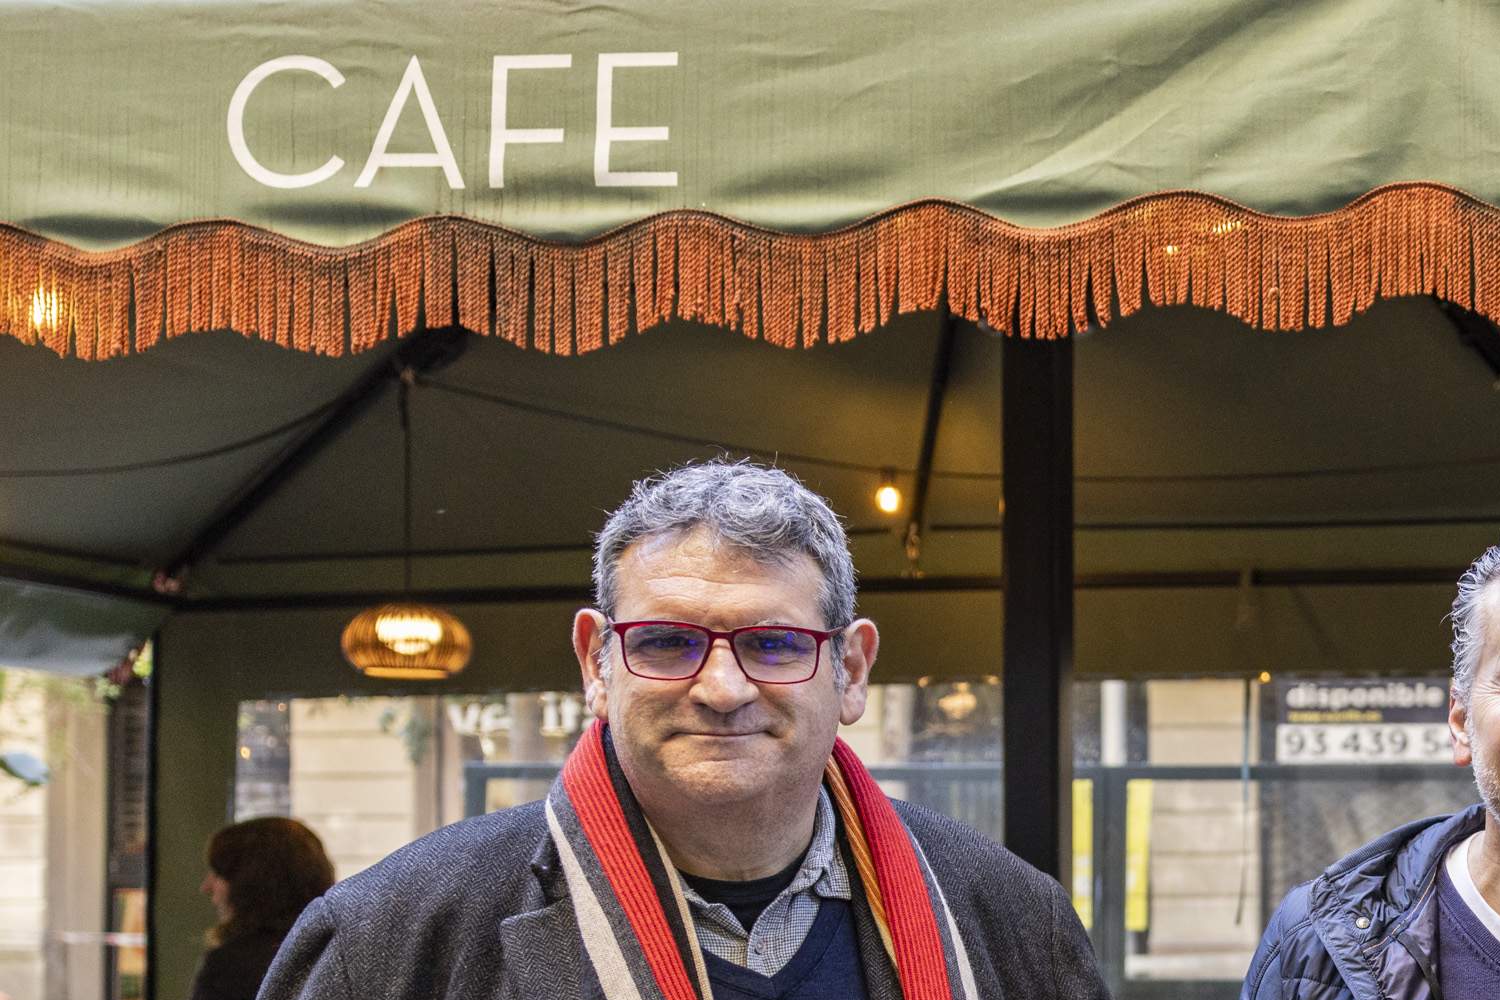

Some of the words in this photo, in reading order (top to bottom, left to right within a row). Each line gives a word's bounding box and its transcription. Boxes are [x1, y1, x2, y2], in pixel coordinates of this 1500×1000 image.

[227, 52, 679, 190] CAFE
[1286, 681, 1446, 711] disponible
[1285, 729, 1328, 755] 93
[1341, 729, 1409, 755] 439
[1424, 729, 1453, 752] 5
